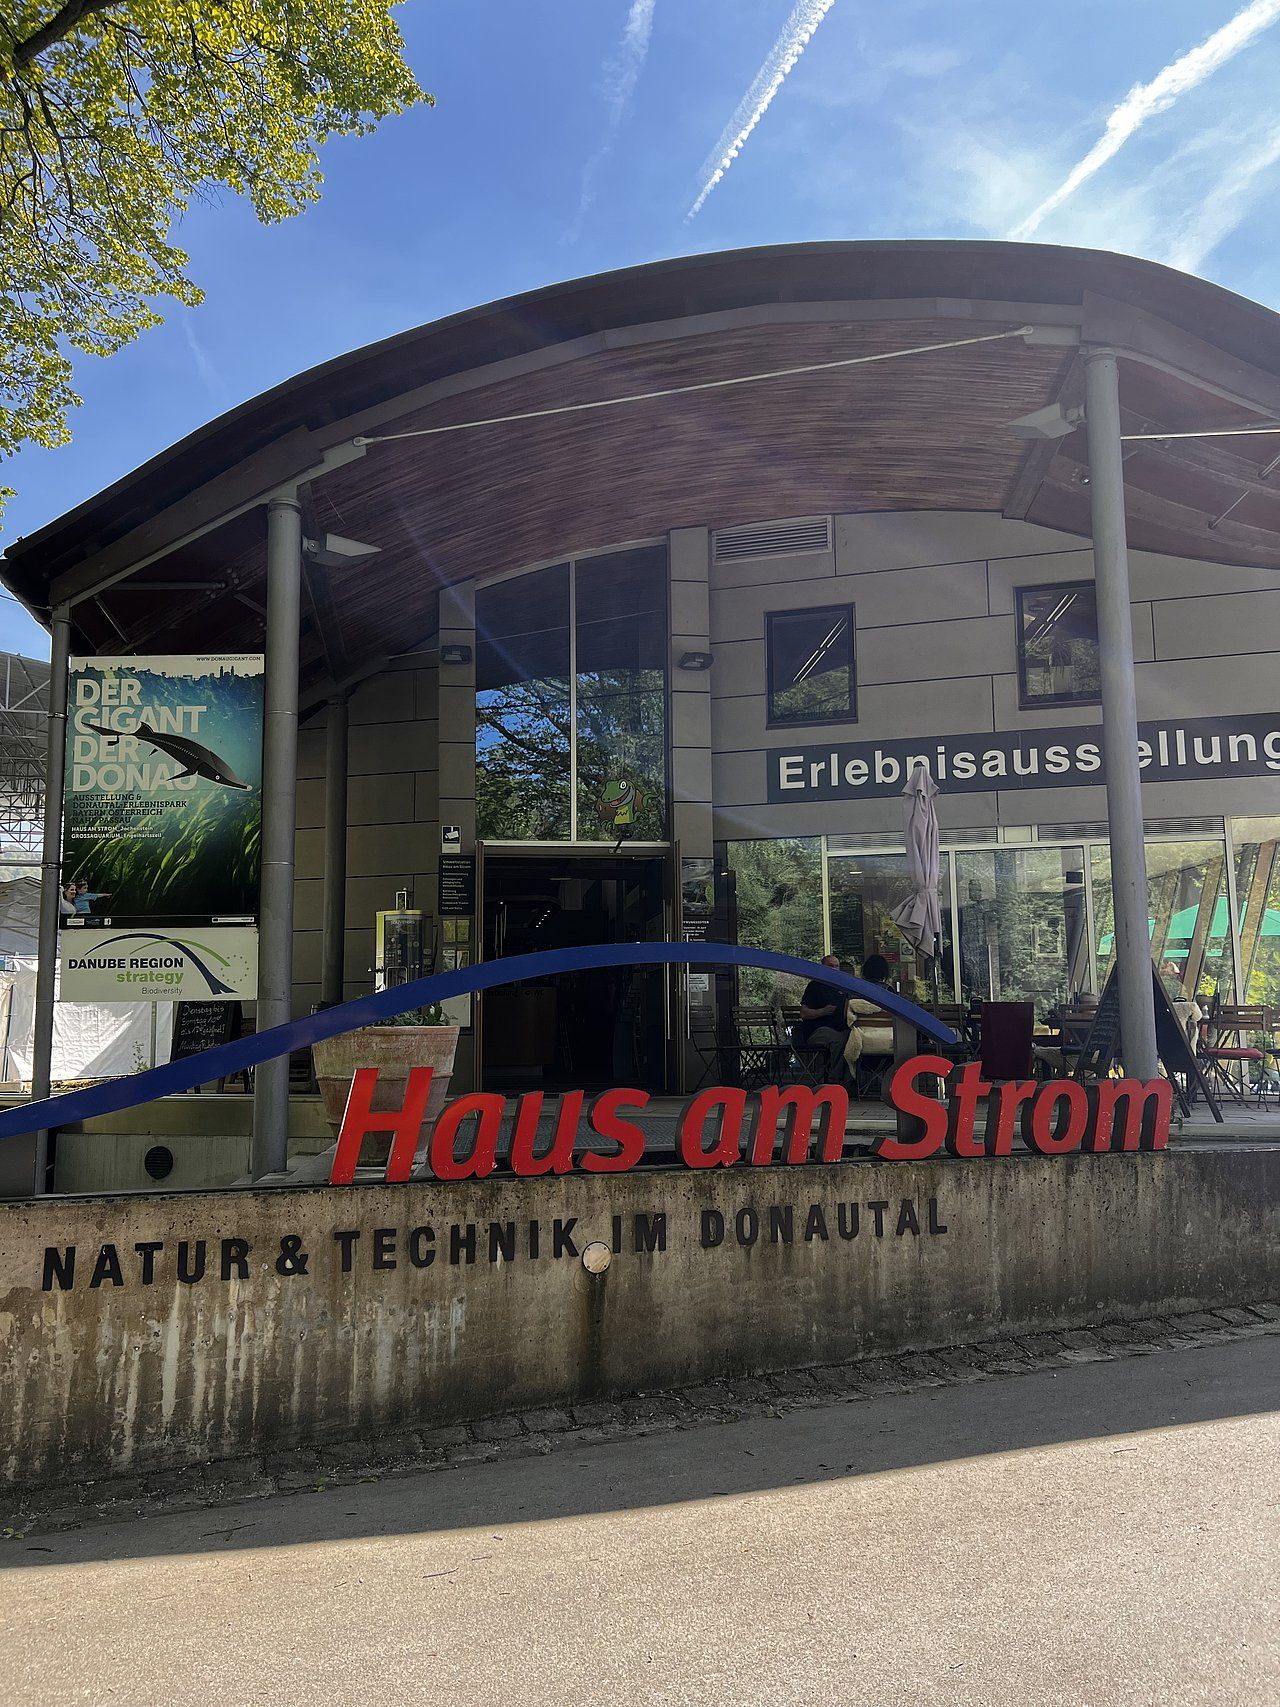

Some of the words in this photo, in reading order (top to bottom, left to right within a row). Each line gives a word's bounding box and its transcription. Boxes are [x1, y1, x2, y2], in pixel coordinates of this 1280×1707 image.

[75, 678, 143, 706] DER
[74, 706, 207, 734] GIGANT
[73, 735, 140, 764] DER
[778, 729, 1280, 790] Erlebnisaussellung
[72, 763, 198, 792] DONAU
[72, 800, 188, 809] DONAUTAL-ERLEBNISPARK
[73, 793, 135, 801] AUSSTELLUNG
[136, 793, 142, 801] &
[98, 816, 132, 824] PASSAU
[68, 958, 127, 970] DANUBE
[129, 957, 184, 969] REGION
[116, 970, 184, 985] strategy
[141, 987, 183, 996] Biodiversity
[329, 1066, 651, 1186] Haus
[675, 1084, 849, 1169] am
[870, 1055, 1174, 1161] Strom
[41, 1238, 250, 1292] NATUR
[275, 1234, 310, 1277] &
[333, 1216, 580, 1273] TECHNIK
[611, 1212, 668, 1254] IM
[700, 1199, 949, 1249] DONAUTAL
